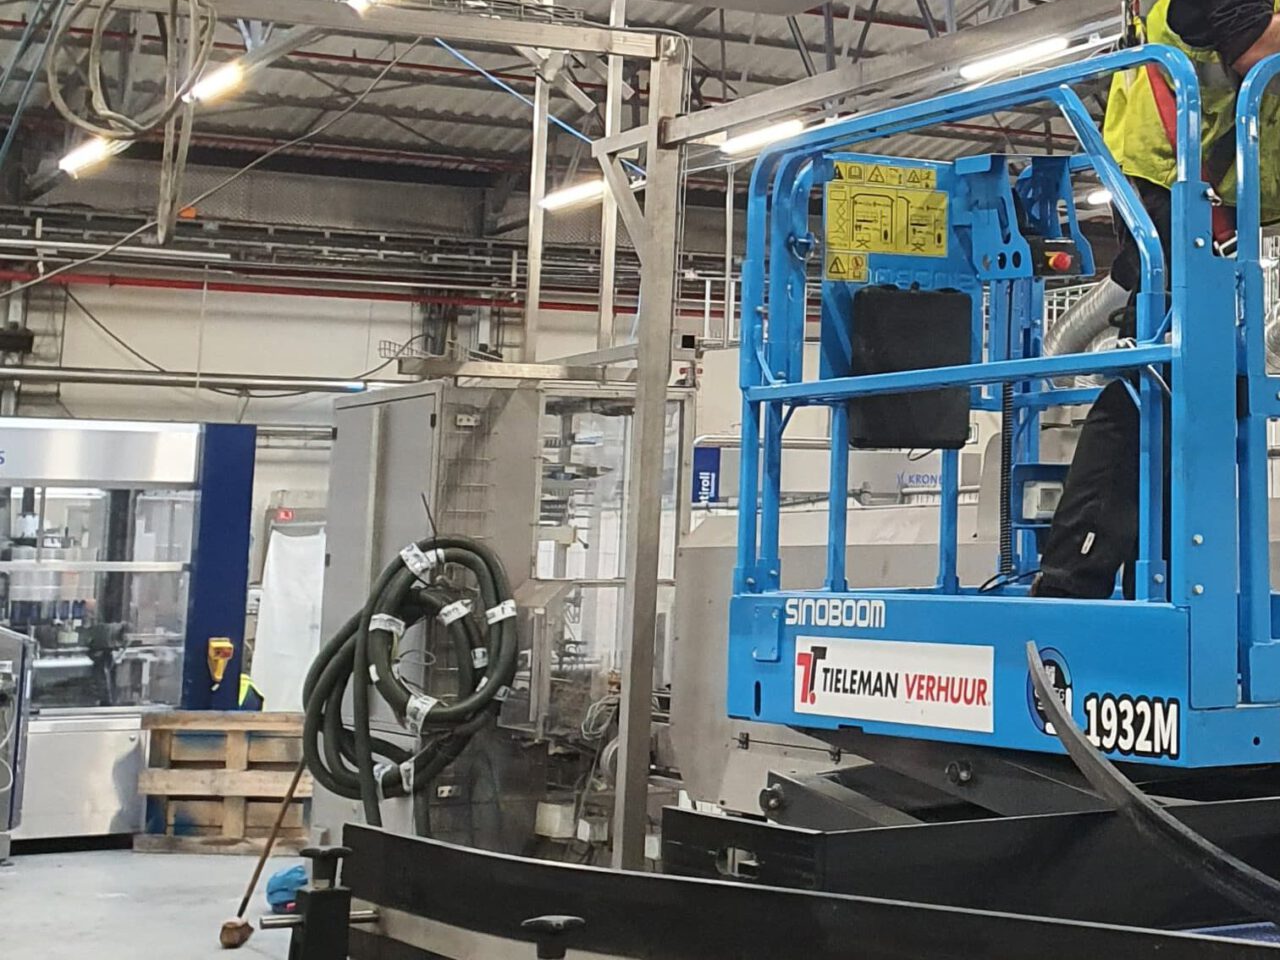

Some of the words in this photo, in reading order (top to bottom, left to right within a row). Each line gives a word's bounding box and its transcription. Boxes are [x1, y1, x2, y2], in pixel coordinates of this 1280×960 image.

[785, 598, 886, 628] SINOBOOM
[822, 667, 899, 699] TIELEMAN
[905, 673, 988, 706] VERHUUR
[1085, 696, 1178, 755] 1932M
